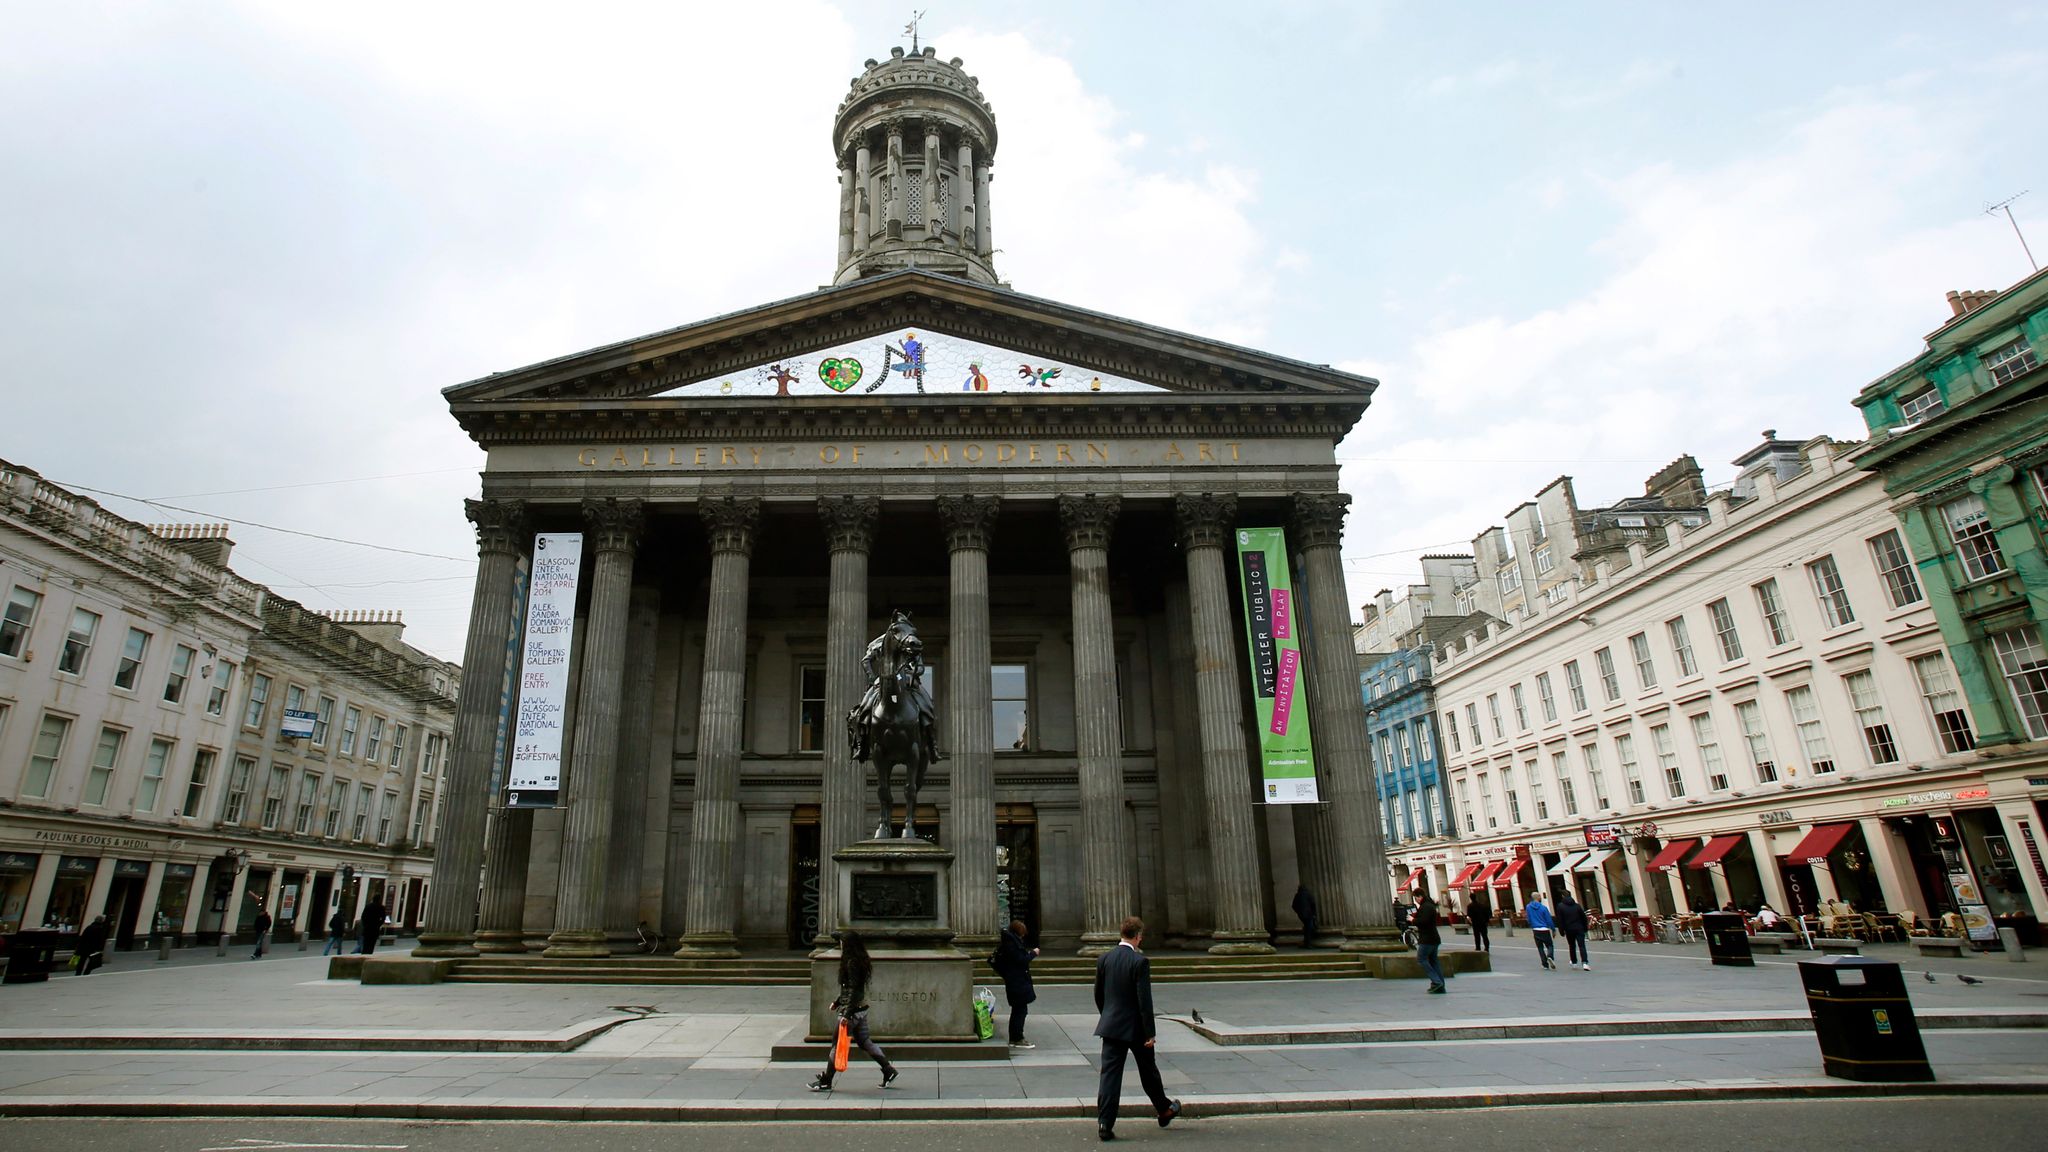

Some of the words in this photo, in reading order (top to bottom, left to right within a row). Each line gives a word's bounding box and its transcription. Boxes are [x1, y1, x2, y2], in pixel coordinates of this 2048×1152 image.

[577, 446, 765, 466] GALLERY
[819, 445, 866, 465] OF
[923, 442, 1109, 464] MODERN
[1164, 442, 1242, 462] ART
[536, 558, 576, 566] GLASGOW
[533, 588, 551, 596] 2014
[1251, 570, 1266, 621] PUBLIC
[1276, 593, 1285, 617] PLAY
[529, 626, 562, 634] GALLERY
[528, 642, 543, 650] SUE
[528, 649, 565, 657] TOMPKINS
[527, 657, 560, 665] GALLERY
[1258, 632, 1275, 694] ATELIER
[1278, 651, 1295, 712] INVITATION
[519, 728, 535, 736] ORG
[1758, 810, 1793, 824] COSTA
[36, 831, 77, 842] PAULINE
[80, 835, 112, 846] BOOKS
[122, 839, 149, 849] MEDIA
[1807, 856, 1824, 864] COSTA
[869, 992, 937, 1002] LLINGTON
